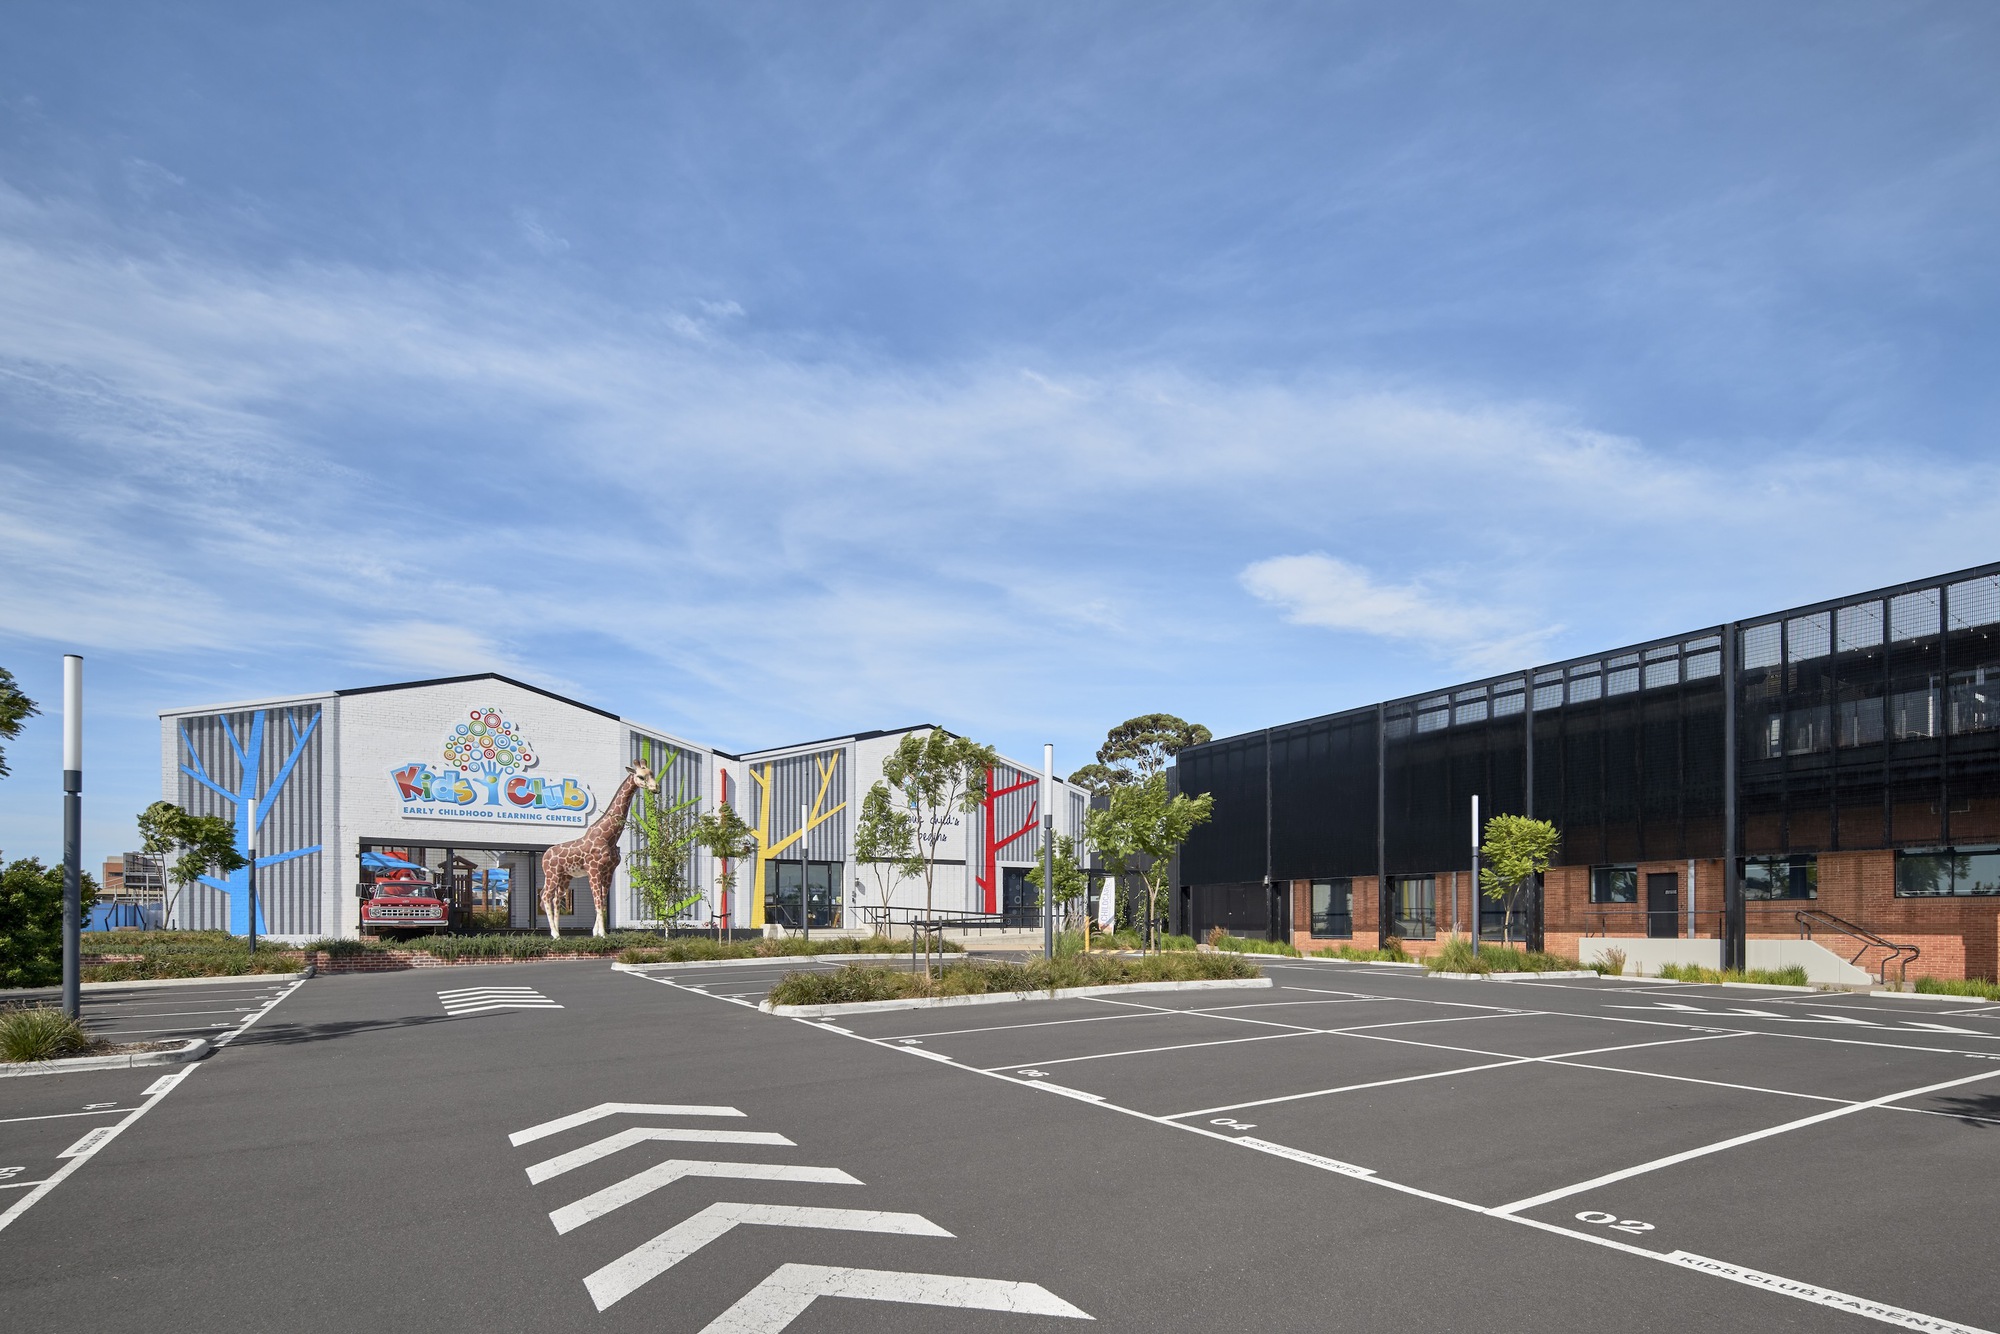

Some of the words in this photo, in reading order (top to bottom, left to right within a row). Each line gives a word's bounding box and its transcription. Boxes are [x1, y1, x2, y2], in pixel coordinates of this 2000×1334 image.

[392, 764, 476, 804] Kids
[505, 775, 588, 811] Club
[403, 807, 434, 815] EARLY
[438, 809, 493, 818] CHILDHOOD
[497, 812, 542, 821] LEARNING
[546, 815, 582, 823] CENTRES
[1210, 1118, 1258, 1131] 04
[1575, 1211, 1655, 1235] 02
[1679, 1256, 1738, 1275] KIDS
[1743, 1274, 1818, 1297] CLUB
[1823, 1295, 1972, 1334] PARENTS
